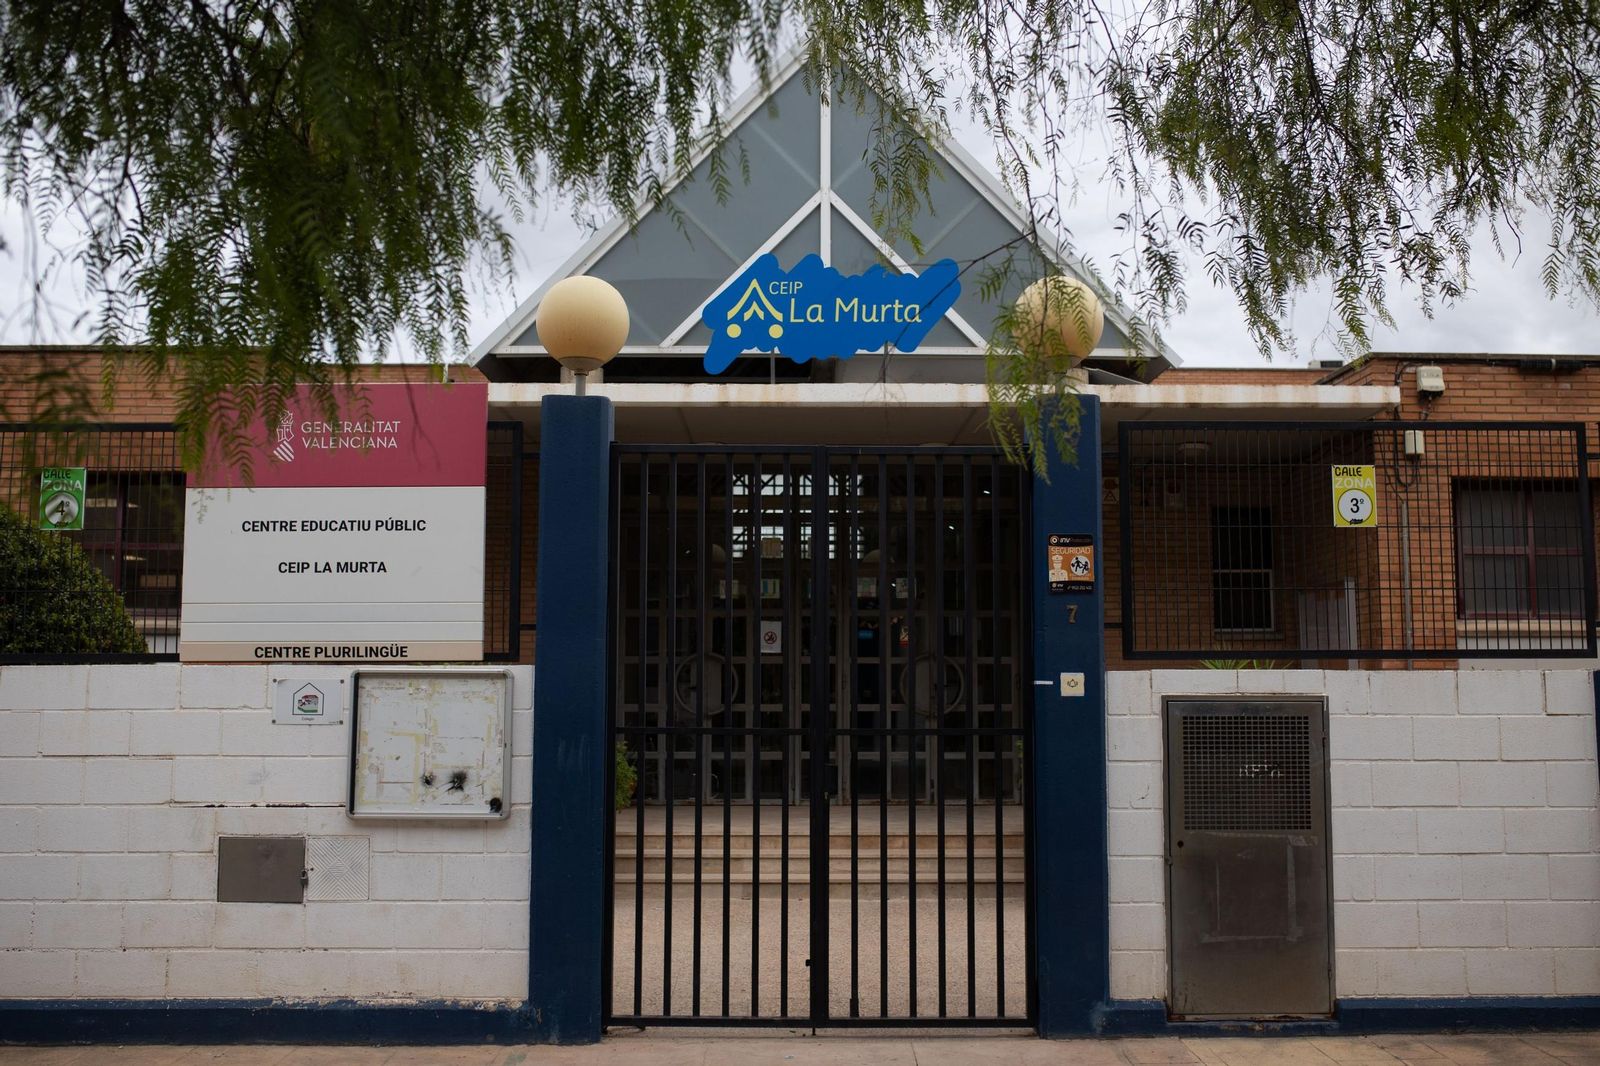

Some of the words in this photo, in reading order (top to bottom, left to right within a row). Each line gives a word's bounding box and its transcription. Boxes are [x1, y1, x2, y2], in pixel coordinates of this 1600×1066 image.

[769, 281, 803, 295] CEIP
[789, 298, 824, 323] La
[835, 297, 922, 323] Murta
[301, 420, 401, 434] GENERALITAT
[301, 436, 399, 449] VALENCIANA
[43, 469, 71, 479] CALLE
[1334, 466, 1363, 477] CALLE
[43, 480, 83, 491] ZONA
[1334, 477, 1374, 488] ZONA
[241, 520, 297, 533] CENTRE
[301, 520, 372, 533] EDUCATIU
[375, 517, 427, 532] PÚBLIC
[1051, 547, 1091, 555] SEGURIDAD
[278, 562, 310, 574] CEIP
[313, 562, 332, 574] LA
[336, 561, 387, 574] MURTA
[1066, 604, 1079, 625] 7
[254, 646, 311, 659] CENTRE
[314, 643, 409, 658] PLURILINGÜE
